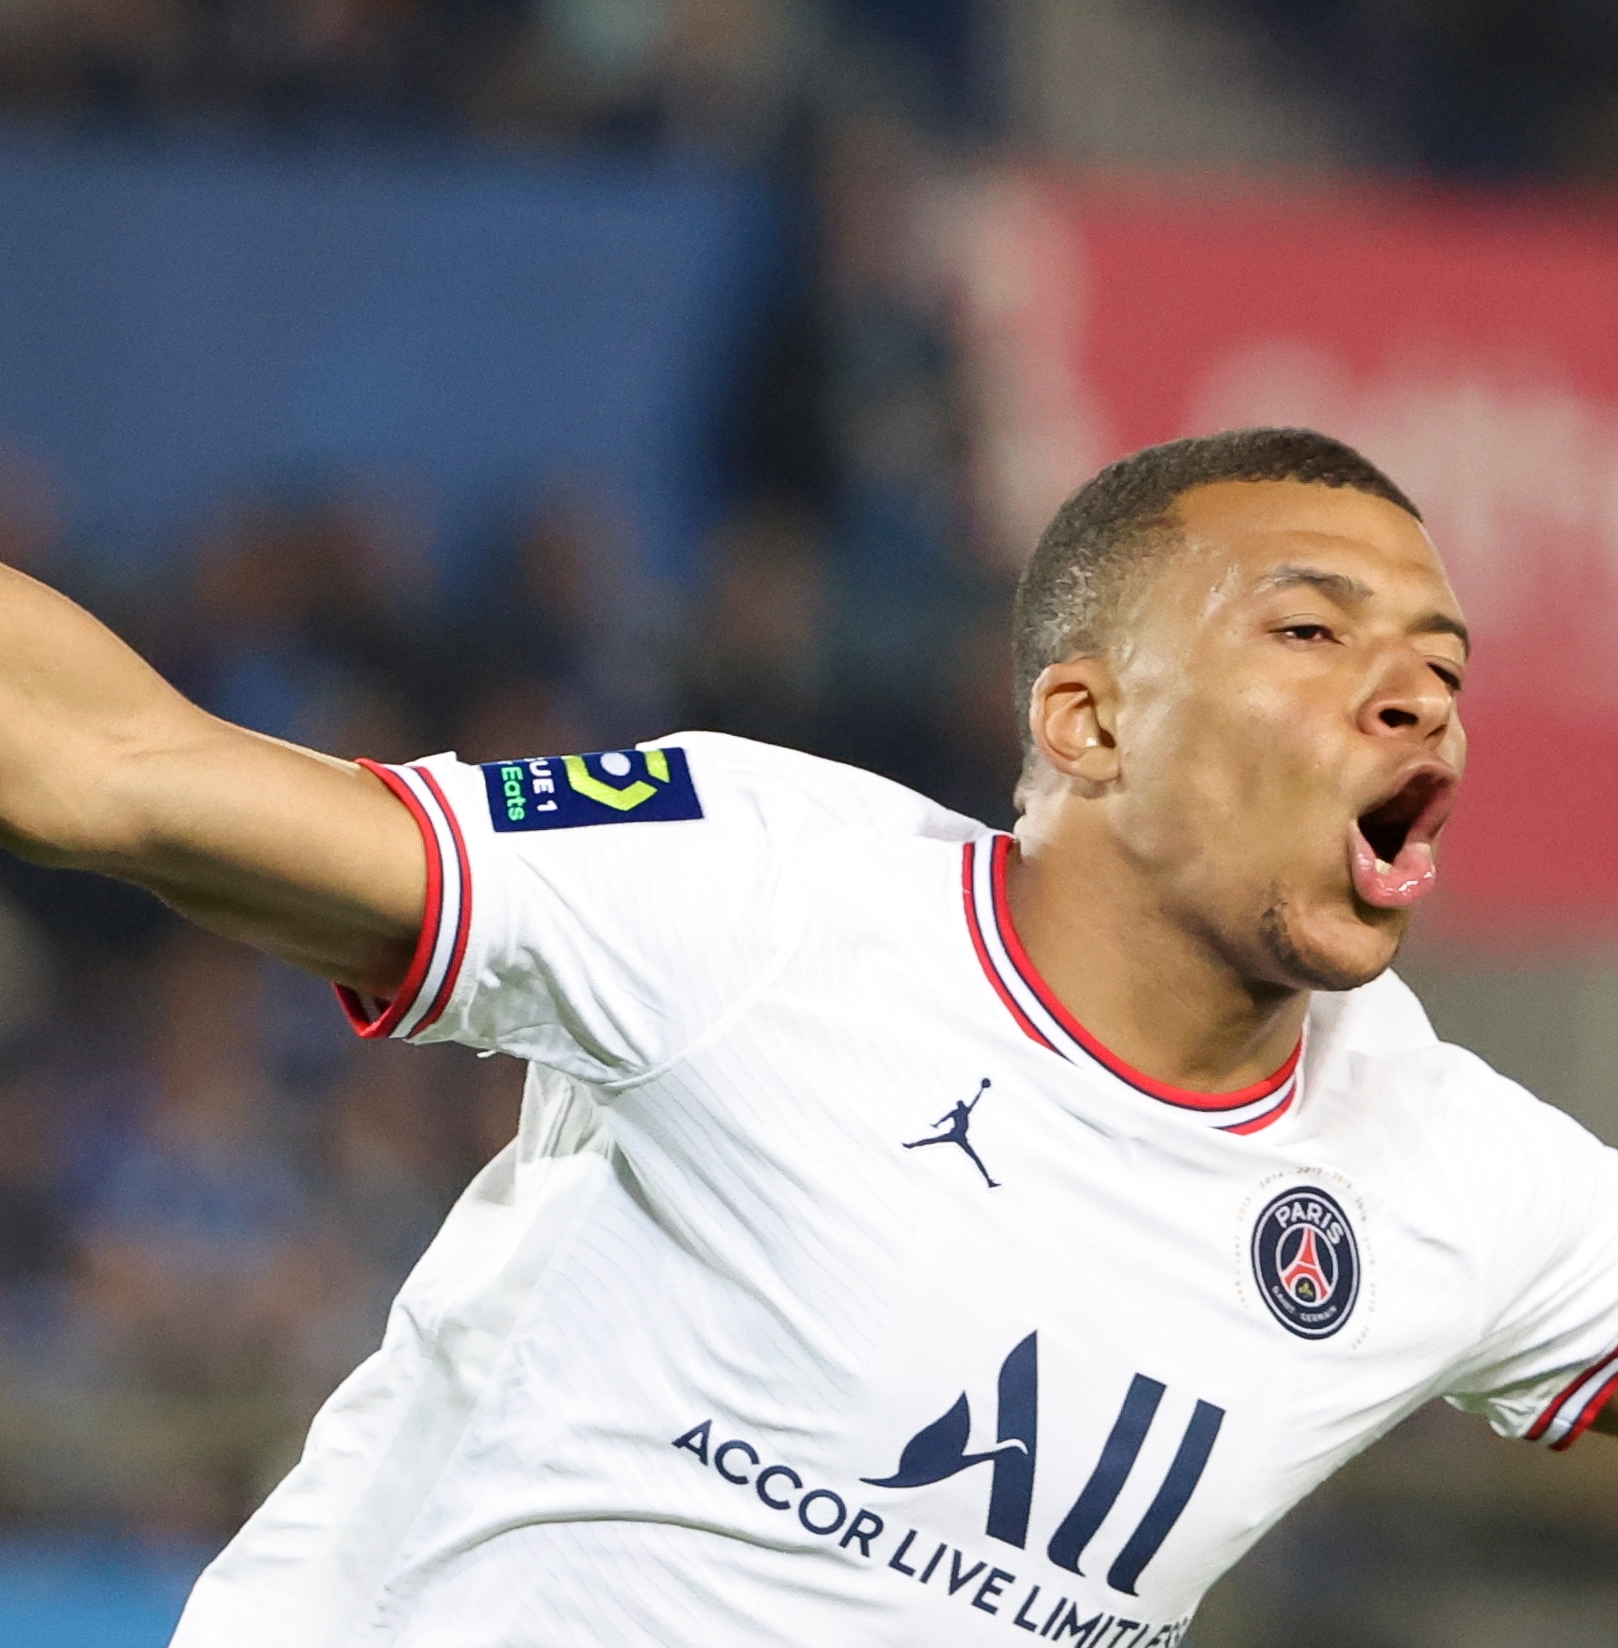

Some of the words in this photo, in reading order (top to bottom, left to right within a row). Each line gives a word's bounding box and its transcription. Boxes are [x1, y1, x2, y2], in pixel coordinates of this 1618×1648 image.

[500, 766, 527, 821] Eats
[536, 800, 559, 812] 1
[1274, 1201, 1344, 1245] PARIS
[671, 1418, 884, 1559] ACCOR
[888, 1528, 1015, 1616] LIVE
